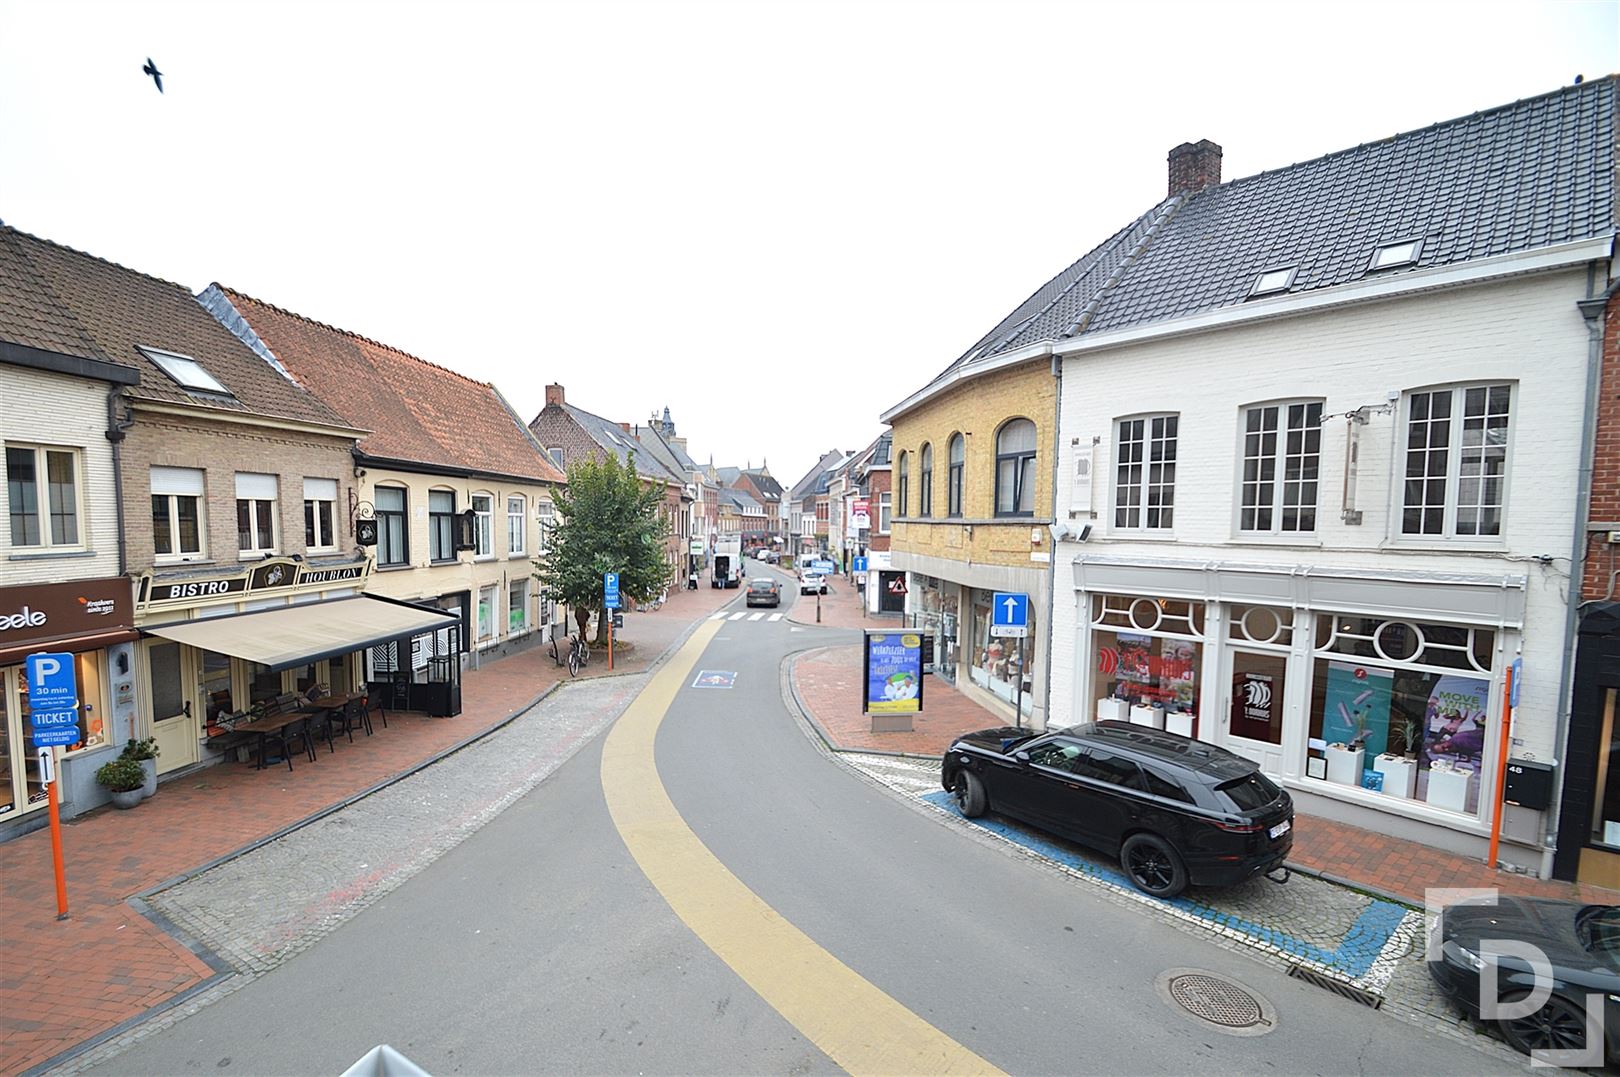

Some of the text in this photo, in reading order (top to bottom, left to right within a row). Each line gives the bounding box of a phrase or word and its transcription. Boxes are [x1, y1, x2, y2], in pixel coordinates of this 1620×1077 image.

[170, 568, 358, 598] BISTRO HOUBLON
[608, 575, 615, 586] P
[36, 658, 61, 686] P
[36, 687, 49, 695] 30
[1439, 691, 1479, 704] MOVE
[35, 712, 72, 724] TICKET
[1508, 766, 1523, 774] 48
